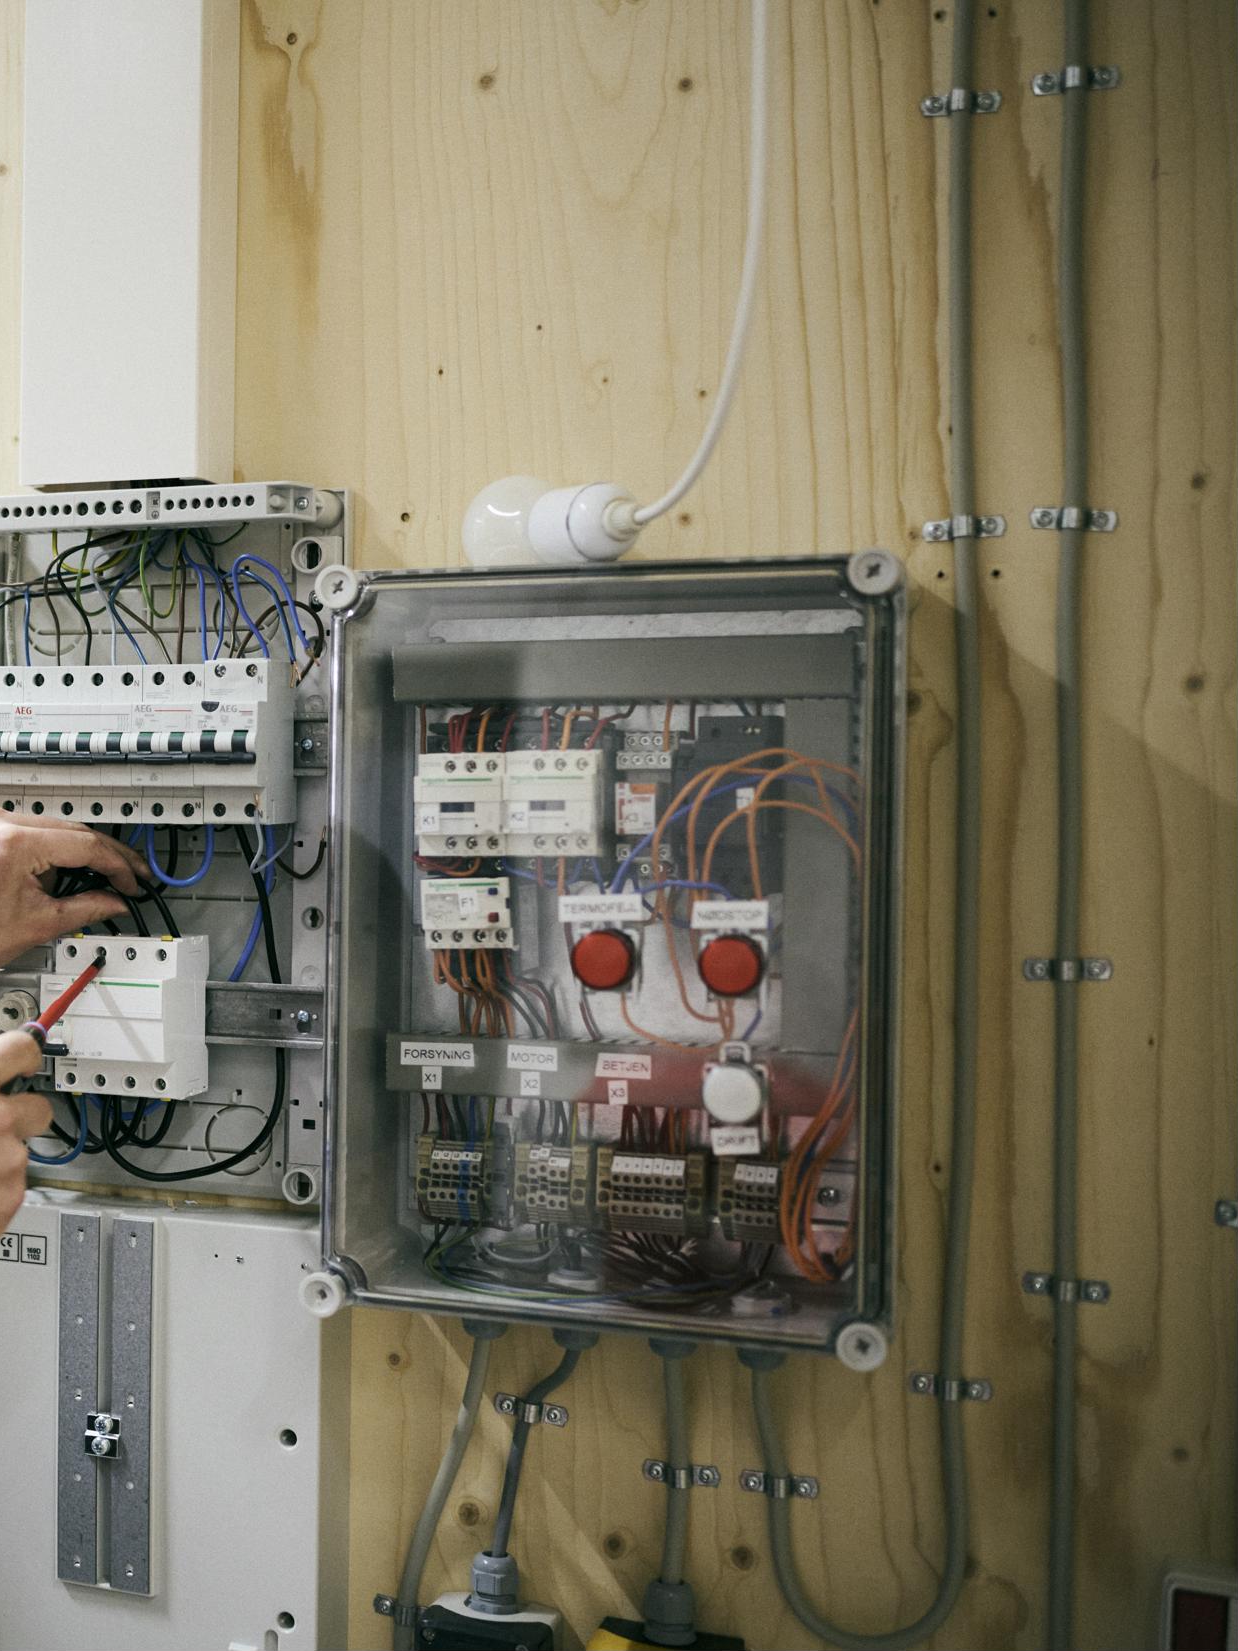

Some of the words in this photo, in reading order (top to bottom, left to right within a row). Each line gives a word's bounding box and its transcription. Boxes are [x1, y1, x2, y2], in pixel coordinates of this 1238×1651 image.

[15, 706, 32, 715] AEG
[134, 704, 152, 713] AEG
[220, 704, 238, 713] AEG
[422, 816, 436, 825] K1
[511, 812, 525, 822] K2
[403, 1048, 472, 1061] FORSYNING
[511, 1052, 555, 1064] MOTOR
[602, 1060, 649, 1073] BETJEN
[424, 1073, 437, 1083] X1
[523, 1079, 539, 1089] X2
[611, 1087, 626, 1098] X3
